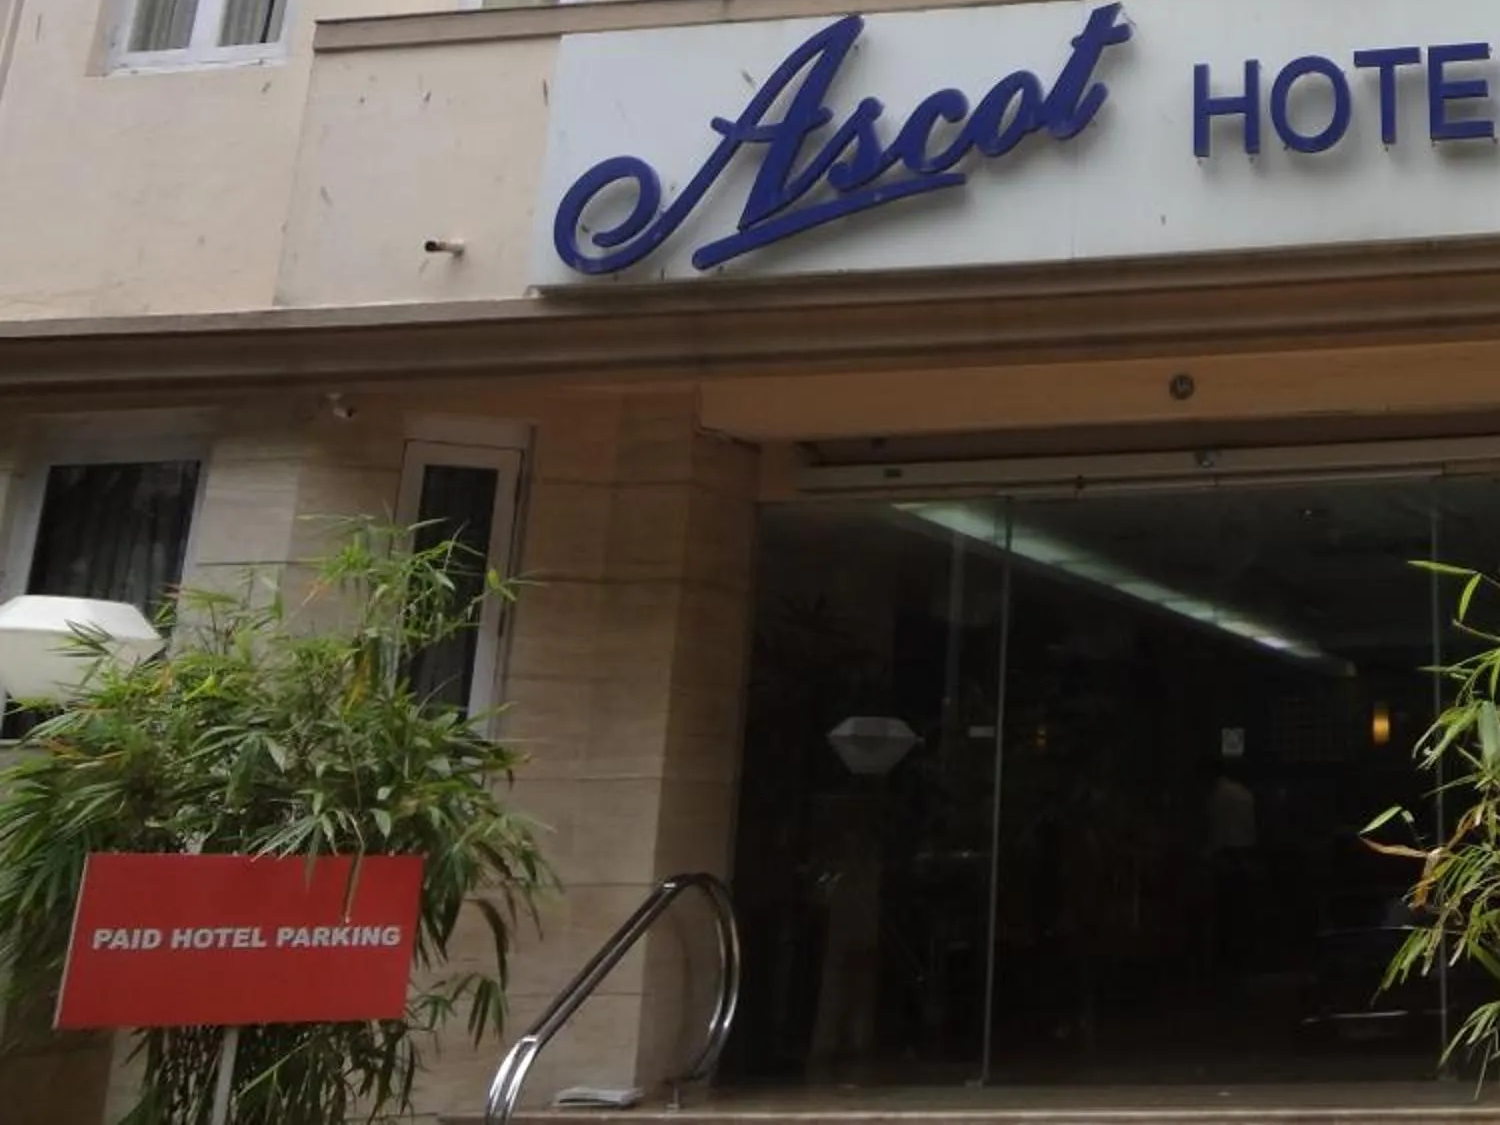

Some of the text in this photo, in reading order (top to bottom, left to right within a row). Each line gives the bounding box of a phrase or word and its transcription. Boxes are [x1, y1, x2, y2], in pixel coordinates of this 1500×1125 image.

[92, 926, 401, 950] PAID HOTEL PARKING
